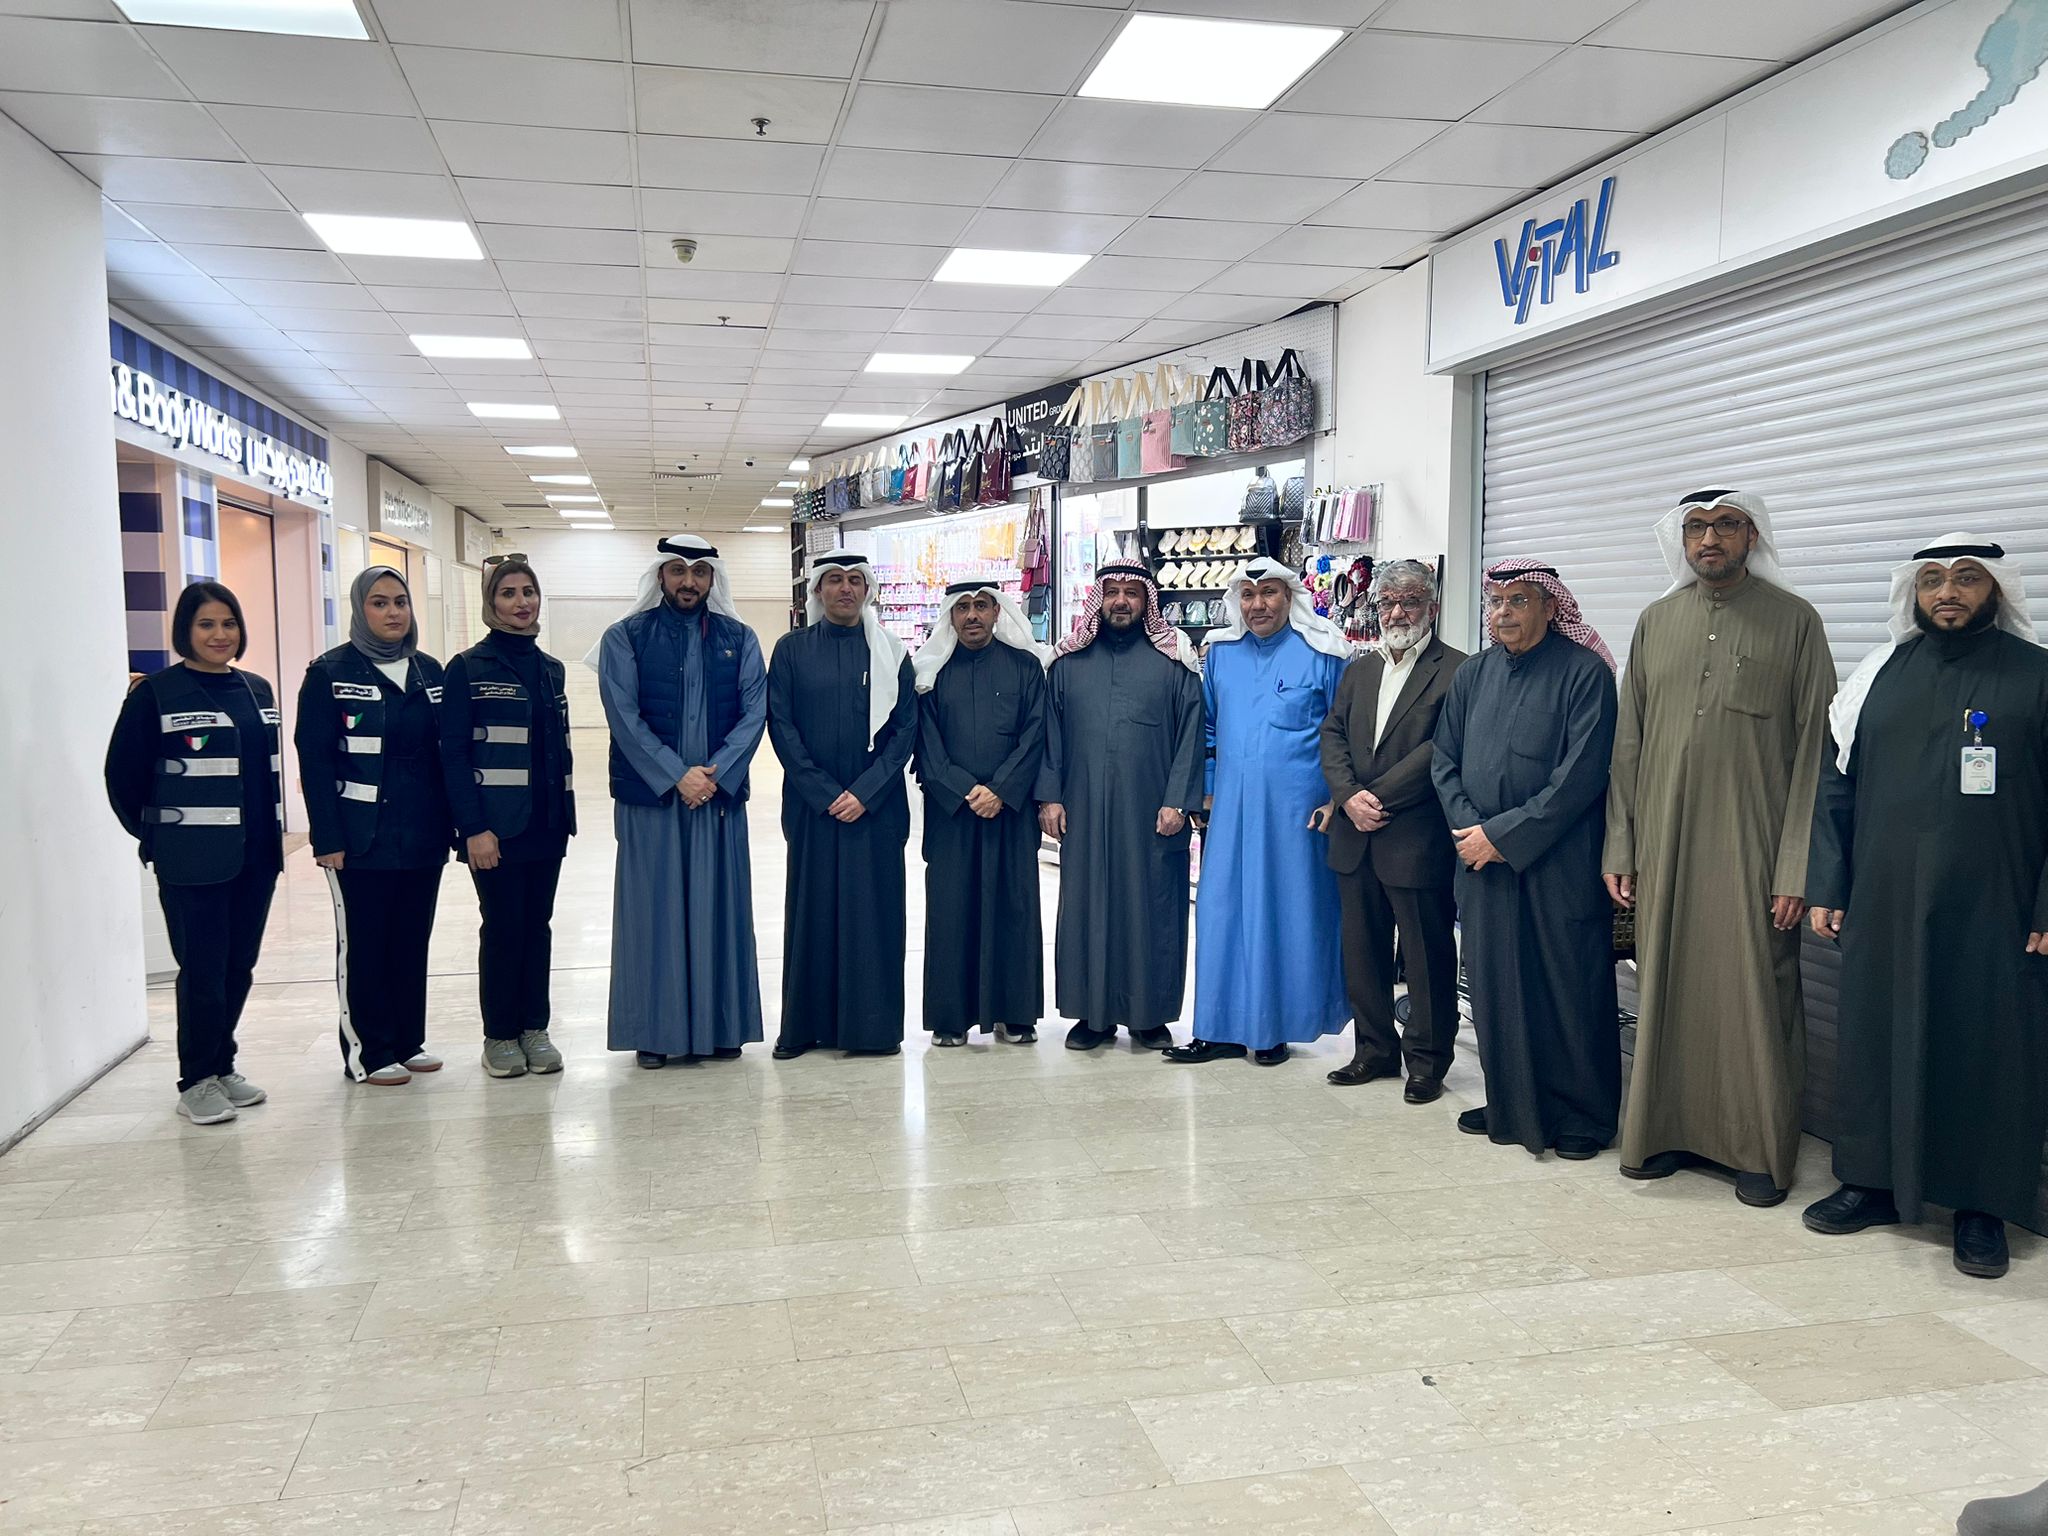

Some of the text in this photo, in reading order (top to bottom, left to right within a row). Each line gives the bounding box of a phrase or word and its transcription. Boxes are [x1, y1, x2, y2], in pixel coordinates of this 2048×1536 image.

[118, 363, 138, 421] &
[137, 370, 191, 451] Body
[189, 397, 243, 463] Works
[1008, 400, 1048, 428] UNITED
